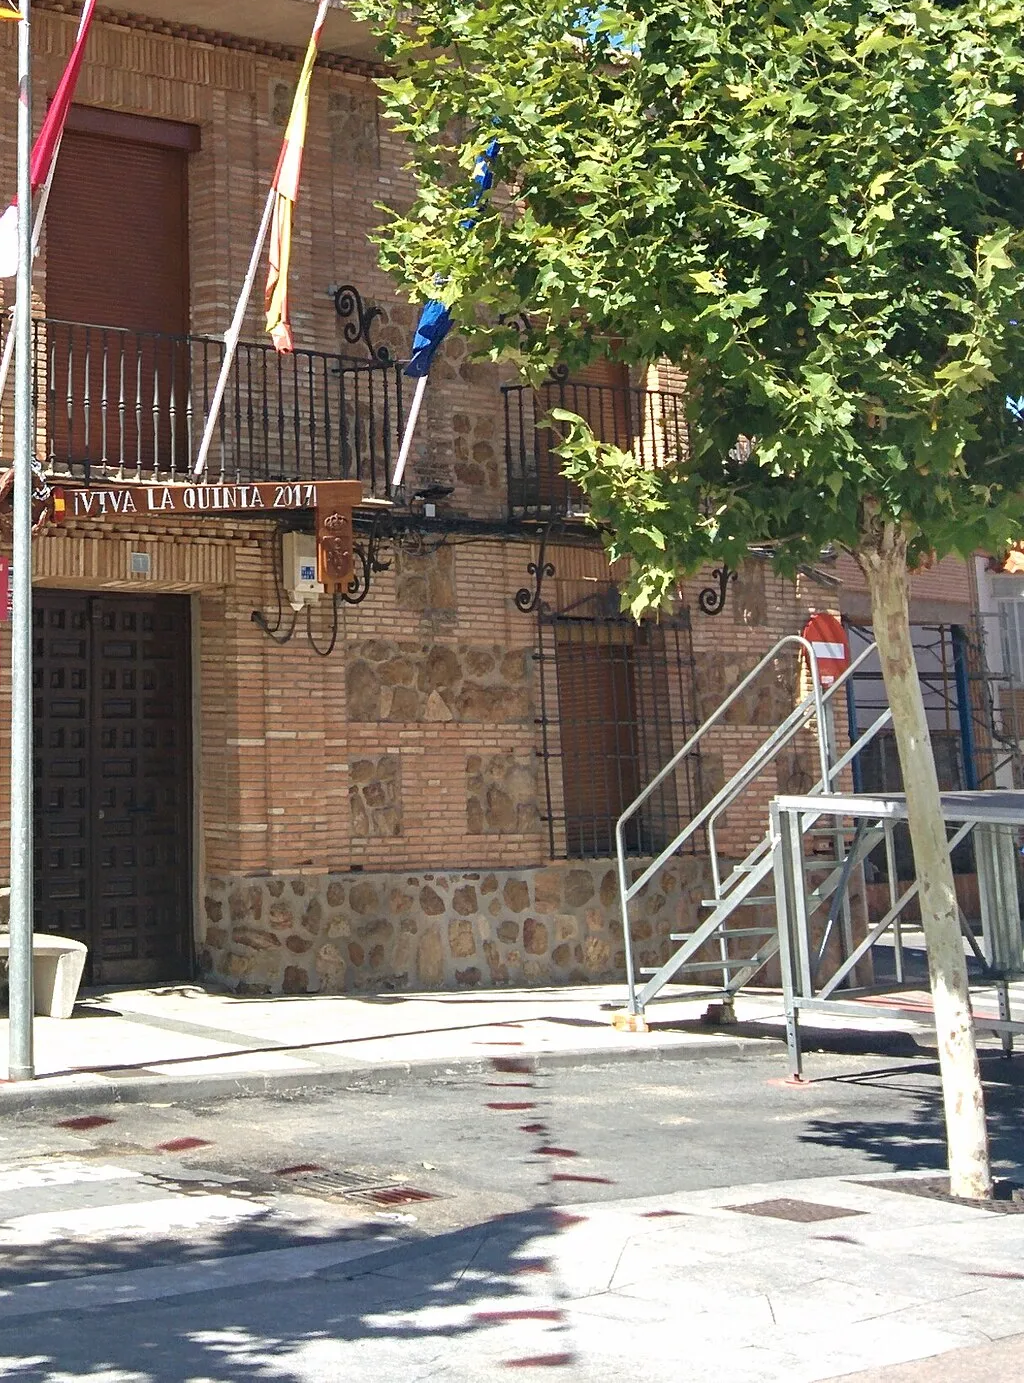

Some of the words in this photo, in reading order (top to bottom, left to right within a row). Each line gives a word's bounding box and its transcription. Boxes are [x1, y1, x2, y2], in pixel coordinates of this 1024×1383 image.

[147, 487, 175, 510] LA
[183, 485, 264, 509] QUINTA
[273, 484, 317, 507] 2017!
